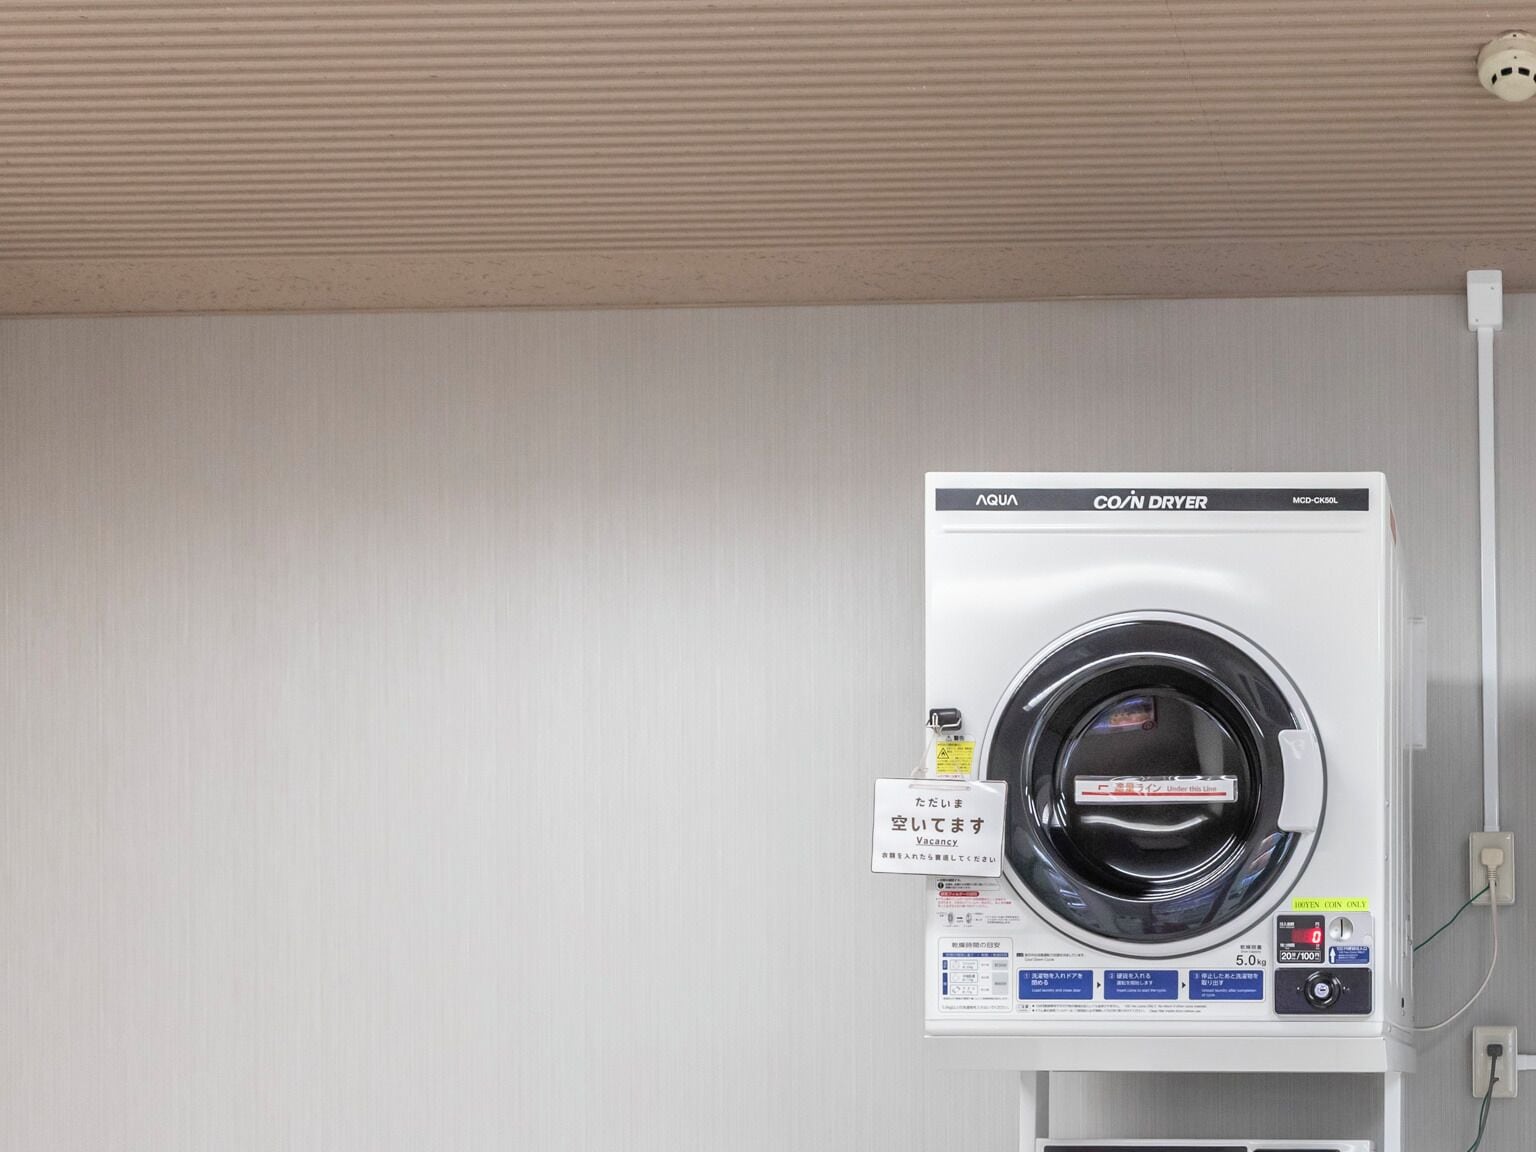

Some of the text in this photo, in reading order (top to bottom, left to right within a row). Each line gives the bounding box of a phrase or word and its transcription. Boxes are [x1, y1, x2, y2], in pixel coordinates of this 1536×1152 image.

[976, 494, 1018, 506] AQUA
[1148, 495, 1208, 509] DRYER
[916, 797, 963, 808] ただいま
[891, 815, 984, 834] 空いてます
[916, 836, 958, 846] Vacancy
[1312, 931, 1322, 943] 0
